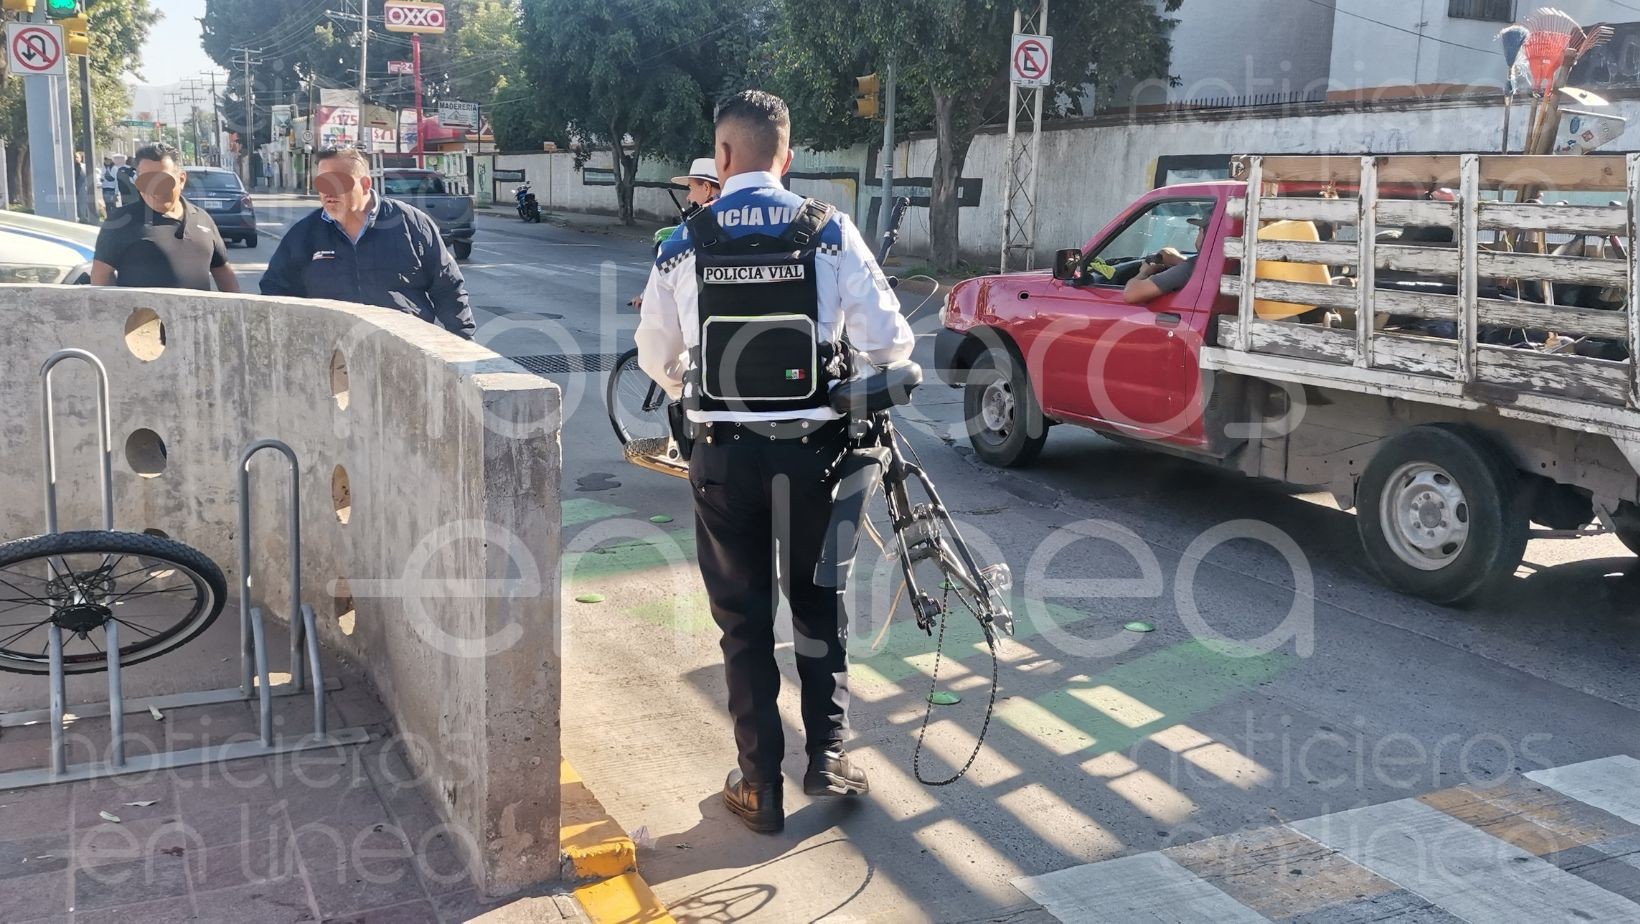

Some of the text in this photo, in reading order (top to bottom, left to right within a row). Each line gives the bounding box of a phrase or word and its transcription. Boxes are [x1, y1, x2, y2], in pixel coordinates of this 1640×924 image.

[388, 7, 443, 27] OXXO
[716, 204, 797, 227] ICÍA VI
[705, 265, 803, 281] POLICIA VIAL
